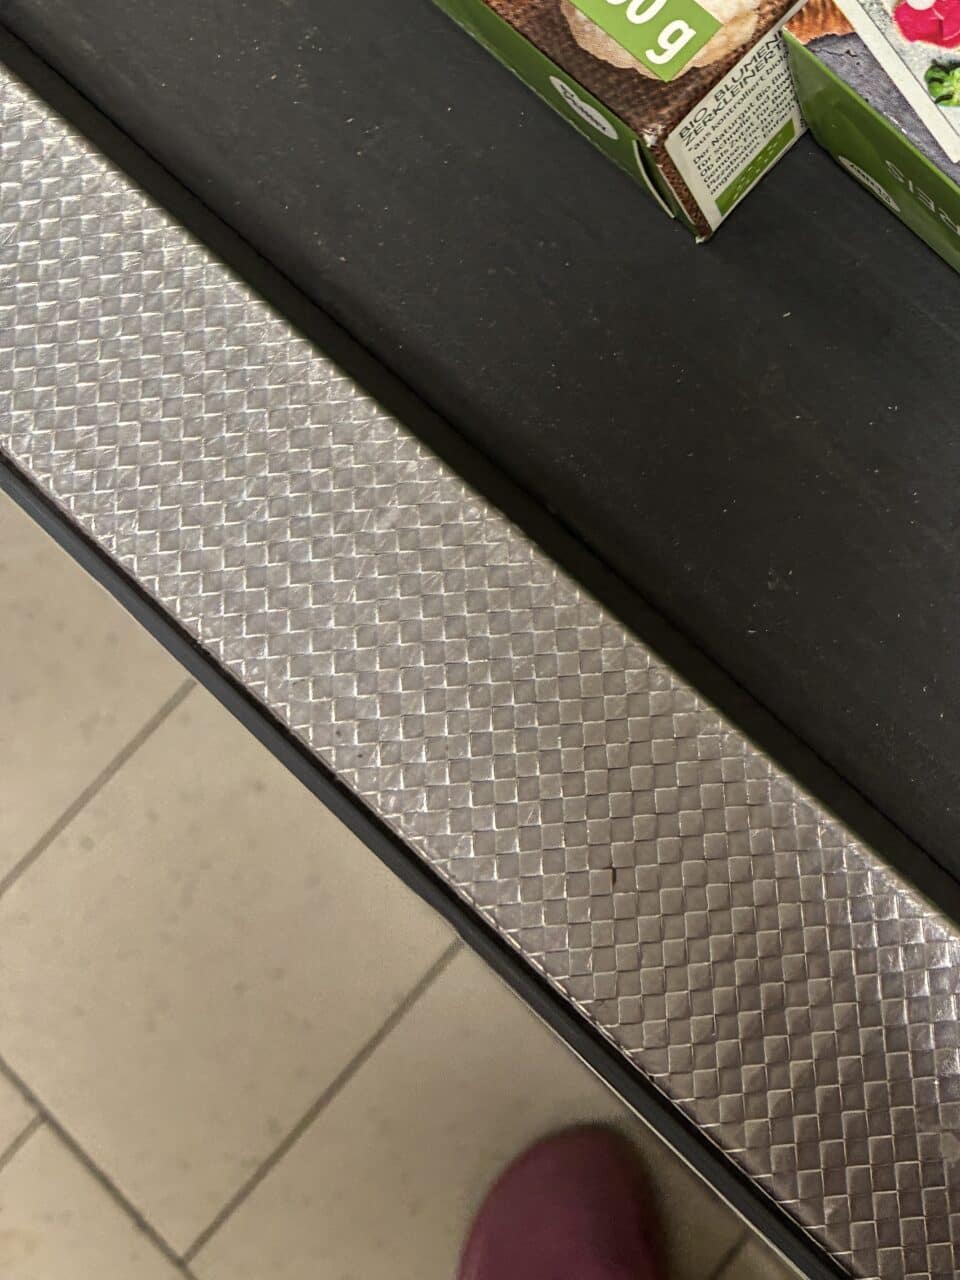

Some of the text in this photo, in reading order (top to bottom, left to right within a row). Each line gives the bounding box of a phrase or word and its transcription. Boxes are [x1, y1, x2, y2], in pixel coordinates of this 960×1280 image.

[646, 19, 697, 65] g
[676, 105, 709, 140] BIO
[711, 27, 784, 104] BLUMEN
[681, 37, 786, 148] ZERKLEINERT
